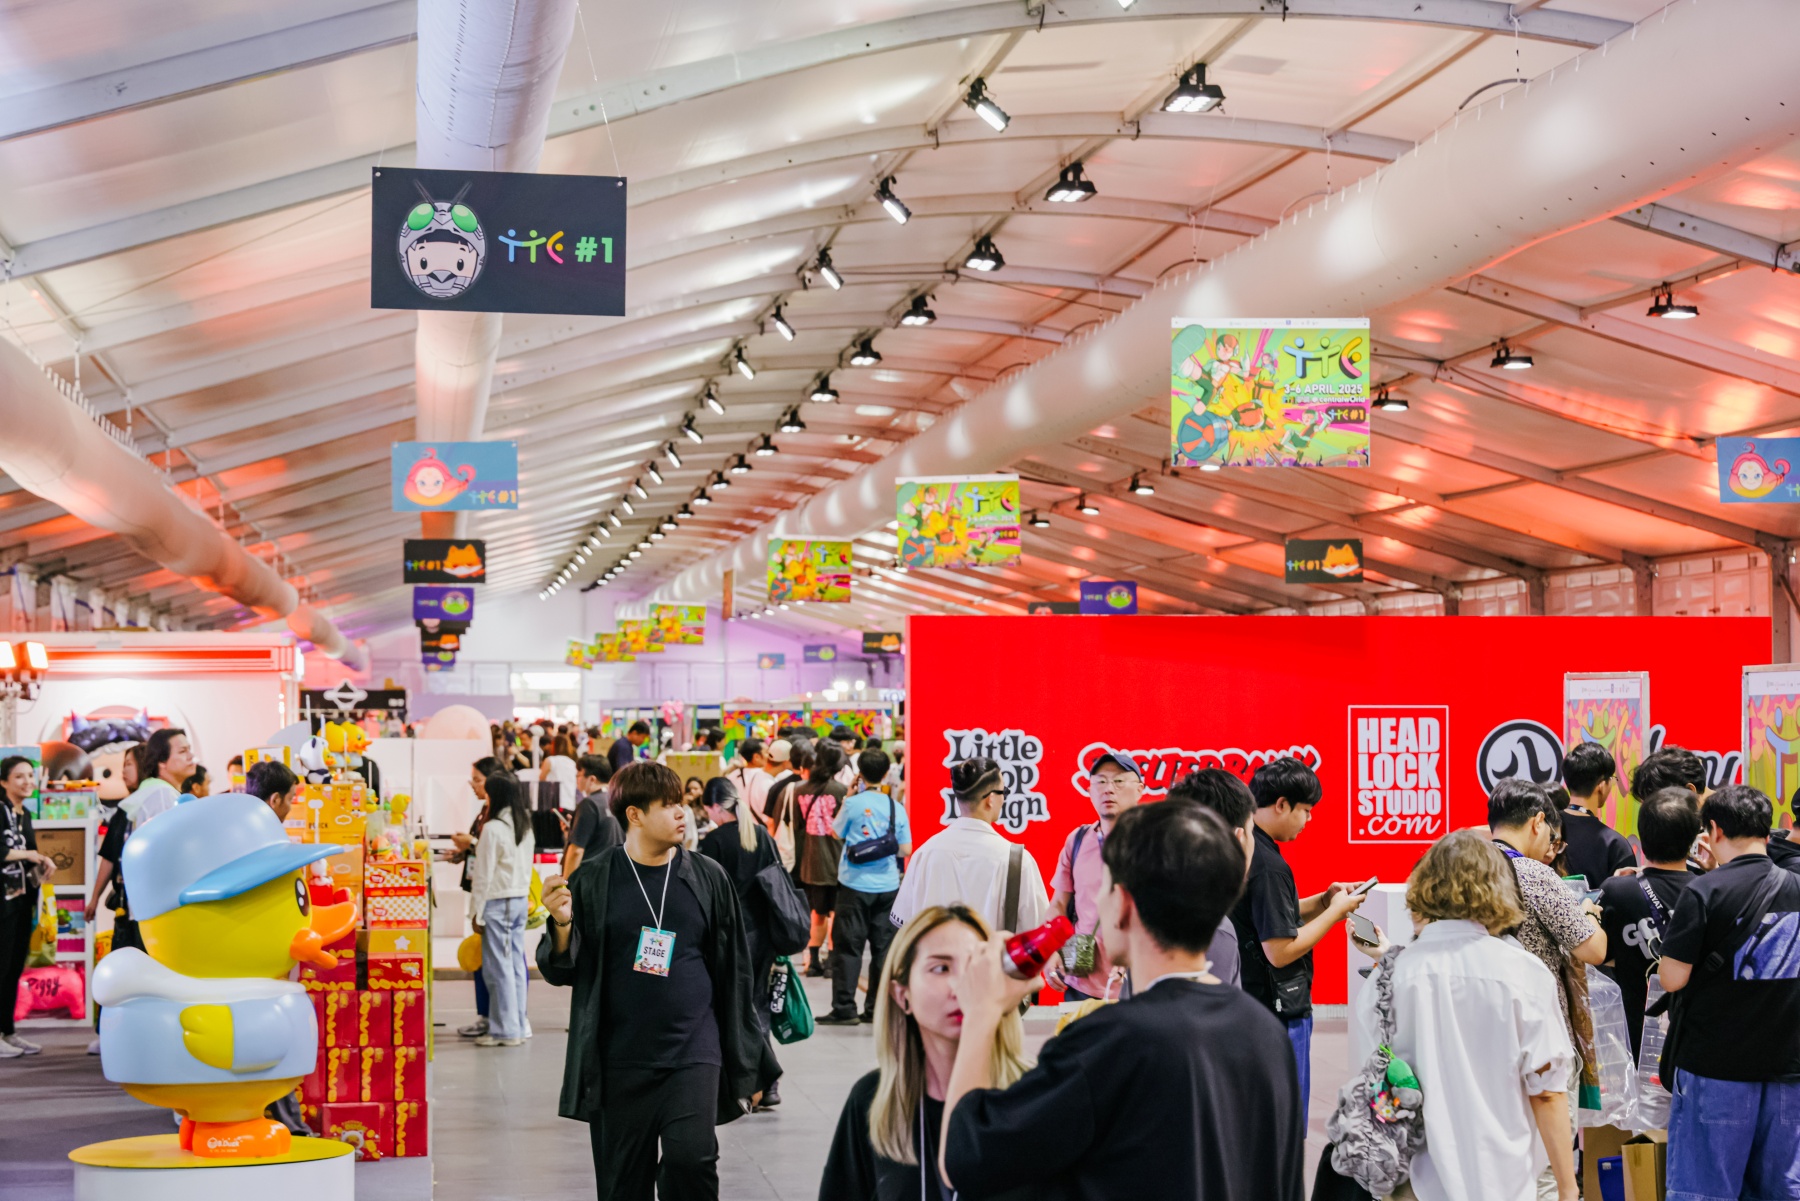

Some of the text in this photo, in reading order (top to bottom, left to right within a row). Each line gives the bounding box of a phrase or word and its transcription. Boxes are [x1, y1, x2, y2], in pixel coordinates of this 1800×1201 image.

[574, 236, 614, 264] #1
[1304, 384, 1335, 394] APRIL
[1338, 384, 1363, 394] 2025
[950, 733, 1038, 762] Little
[1357, 717, 1441, 754] HEAD
[1357, 752, 1442, 790] LOCK
[1357, 788, 1442, 816] STUDIO
[1358, 815, 1442, 836] .com
[643, 946, 665, 958] STAGE
